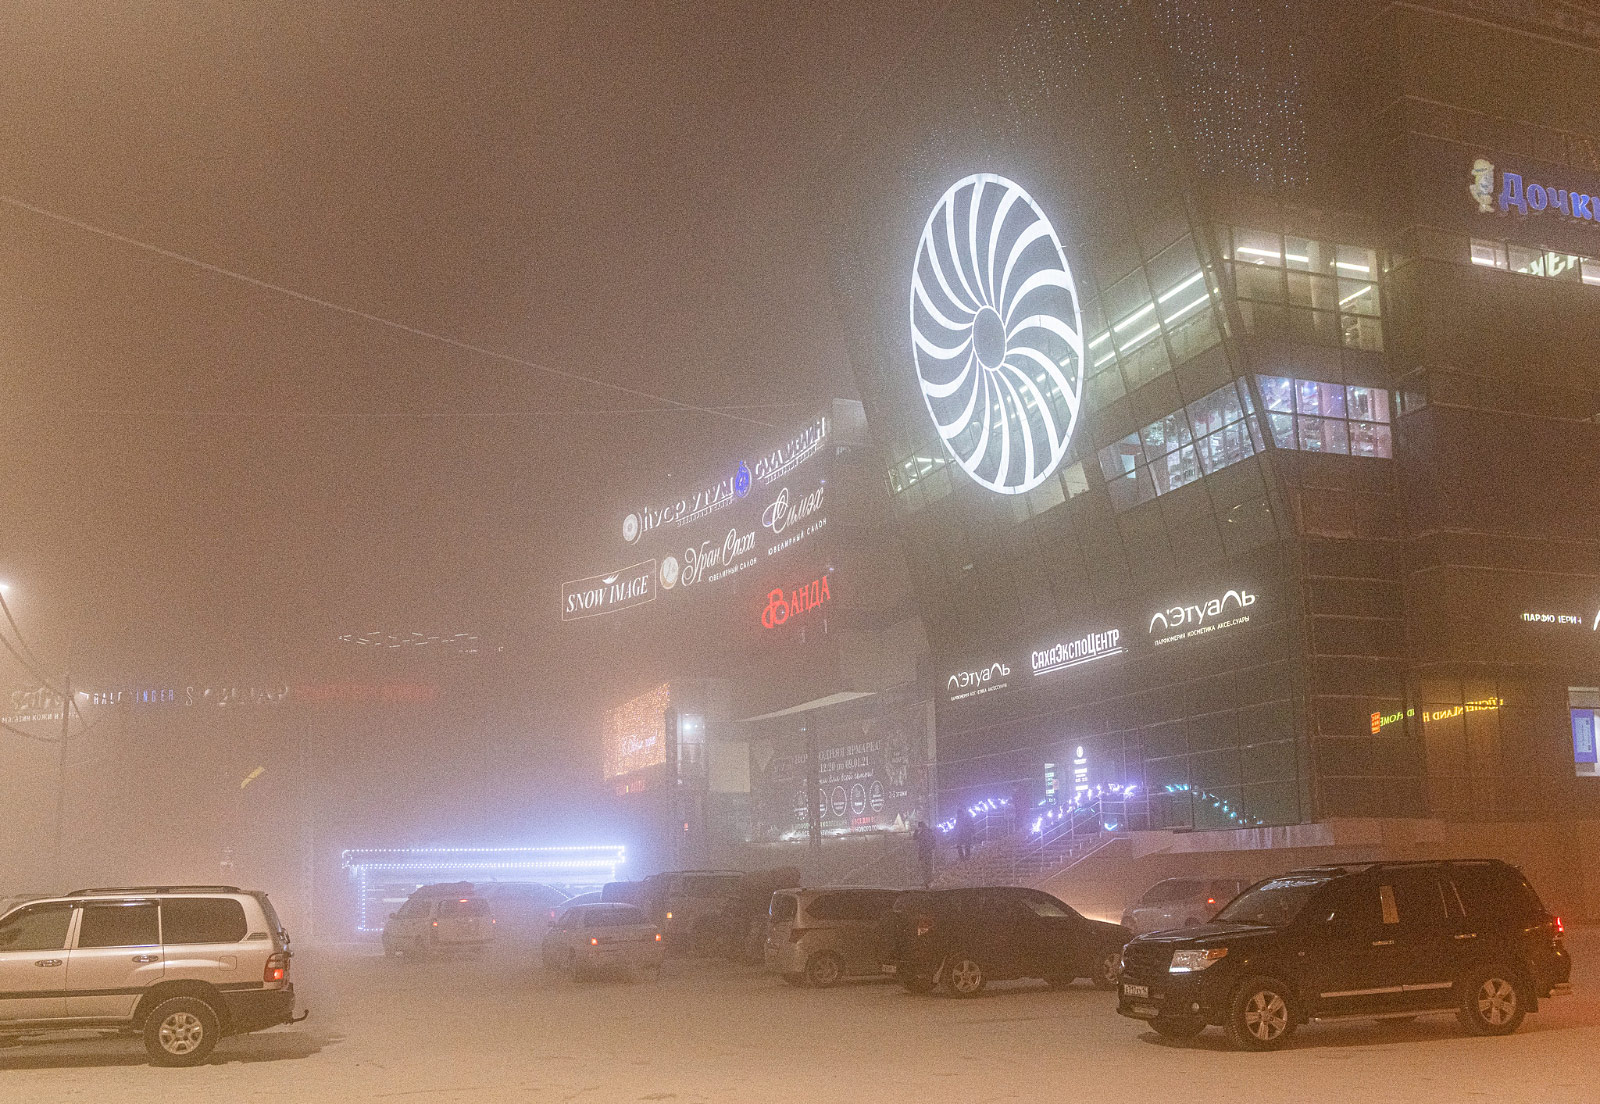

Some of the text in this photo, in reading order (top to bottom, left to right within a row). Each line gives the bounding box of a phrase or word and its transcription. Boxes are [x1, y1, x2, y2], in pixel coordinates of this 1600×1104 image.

[807, 517, 827, 535] САЛОН
[566, 574, 649, 614] SNOW IMAGE
[129, 689, 174, 703] INGER
